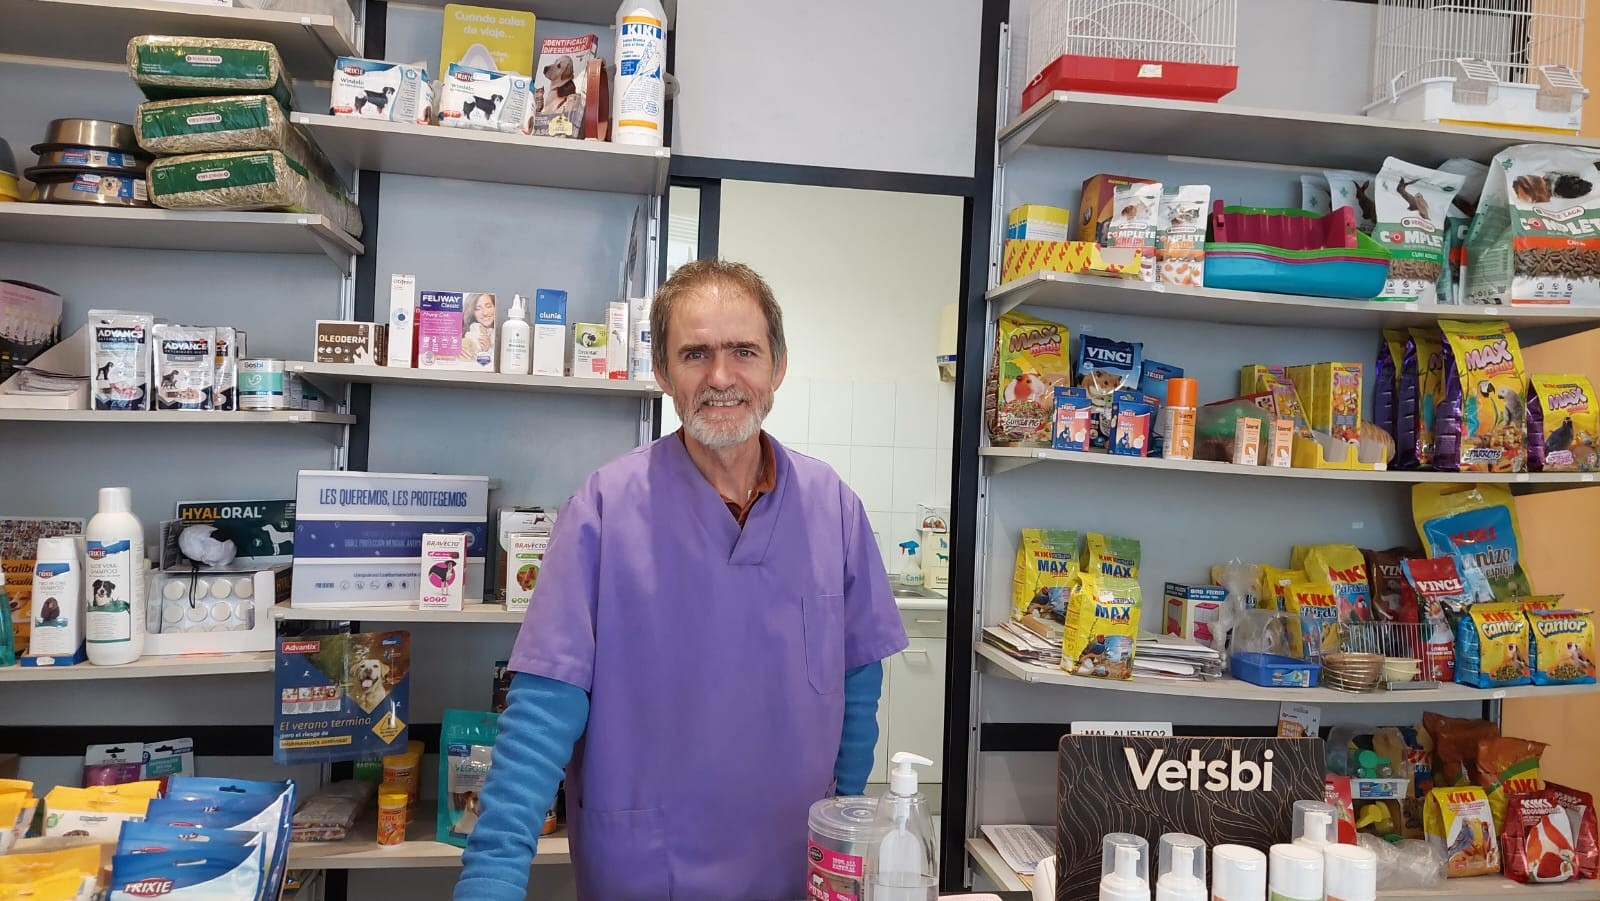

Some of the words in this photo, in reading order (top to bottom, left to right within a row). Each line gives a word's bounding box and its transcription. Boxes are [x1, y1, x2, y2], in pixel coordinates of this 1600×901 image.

[455, 11, 496, 25] Cuando
[499, 16, 526, 27] sales
[463, 25, 478, 35] de
[627, 23, 657, 39] KIKI
[1520, 217, 1600, 235] COMPLET
[1380, 230, 1444, 247] COMPLE
[1014, 241, 1030, 274] KIKI
[422, 294, 461, 303] FELIWAY
[539, 312, 562, 320] clunia
[164, 342, 208, 351] ADVANCE
[318, 334, 367, 344] OLEODERM
[1009, 325, 1062, 353] MAX
[1086, 346, 1133, 364] VINCI
[1465, 340, 1513, 372] MAX
[1548, 387, 1588, 411] MAX
[1469, 448, 1502, 458] PARROTS
[319, 488, 337, 505] LES
[339, 488, 391, 507] QUEREMOS,
[392, 490, 409, 506] LES
[411, 490, 468, 507] PROTEGEMOS
[182, 506, 263, 520] HYALORAL
[1034, 550, 1053, 559] KIKI
[1, 563, 34, 574] Scalib
[1037, 559, 1069, 573] MAX
[1101, 562, 1131, 578] MAX
[1379, 564, 1402, 576] VIN
[1416, 578, 1464, 592] VINCI
[1297, 592, 1337, 607] KIKI
[1095, 604, 1131, 620] MAX
[1481, 612, 1515, 622] KIKI
[1481, 620, 1524, 638] cantor
[1537, 619, 1587, 637] cantor
[284, 643, 317, 652] Advantix
[279, 722, 289, 731] El
[292, 720, 328, 730] verano
[331, 716, 371, 729] termina
[1124, 747, 1274, 793] Vetsbi
[1502, 778, 1538, 794] KIKI
[1446, 791, 1476, 804] KIKI
[124, 879, 174, 895] TRIXIE
